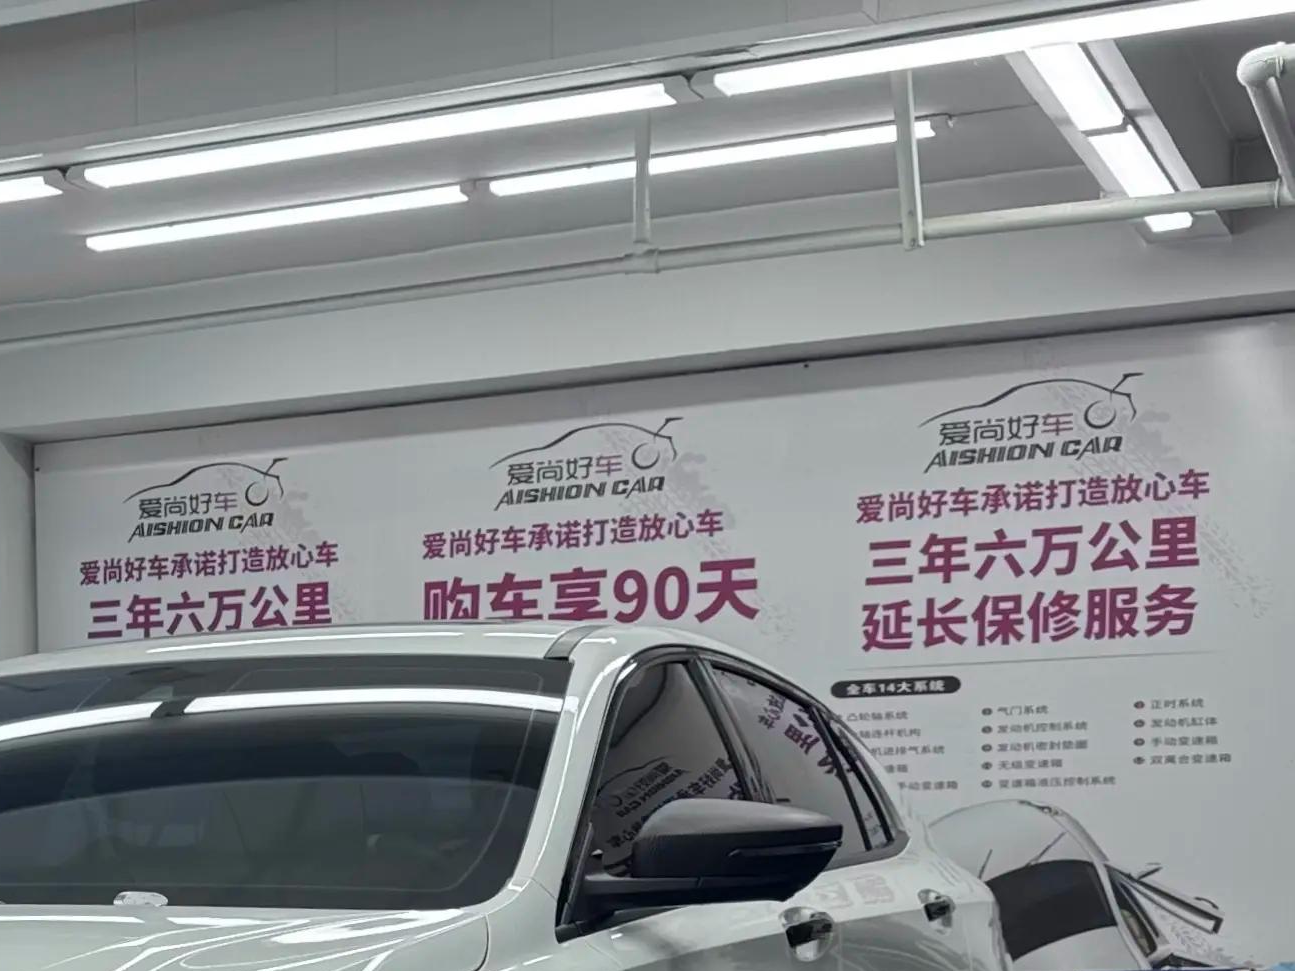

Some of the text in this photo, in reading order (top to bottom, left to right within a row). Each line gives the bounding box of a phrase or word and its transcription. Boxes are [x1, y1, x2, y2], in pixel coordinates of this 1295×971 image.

[939, 412, 1074, 447] 爱尚好车
[507, 455, 623, 486] 爱尚好车
[924, 436, 1123, 473] AISHION CAR
[139, 492, 238, 520] 爱尚好车
[494, 476, 666, 511] AISHION CAR
[856, 469, 1210, 524] 爱尚好车承诺打造放心车
[128, 512, 274, 543] AISHION CAR
[422, 509, 724, 560] 爱尚好车承诺打造放心车
[79, 541, 339, 586] 爱尚好车承诺打造放心车
[865, 516, 1200, 586] 三年六万公里
[88, 581, 333, 639] 三年六万公里
[861, 584, 1199, 652] 延长保修服务
[846, 680, 946, 696] 全车14大系统
[1150, 698, 1204, 710] 正时系统
[857, 728, 921, 740] 轴连杆机构
